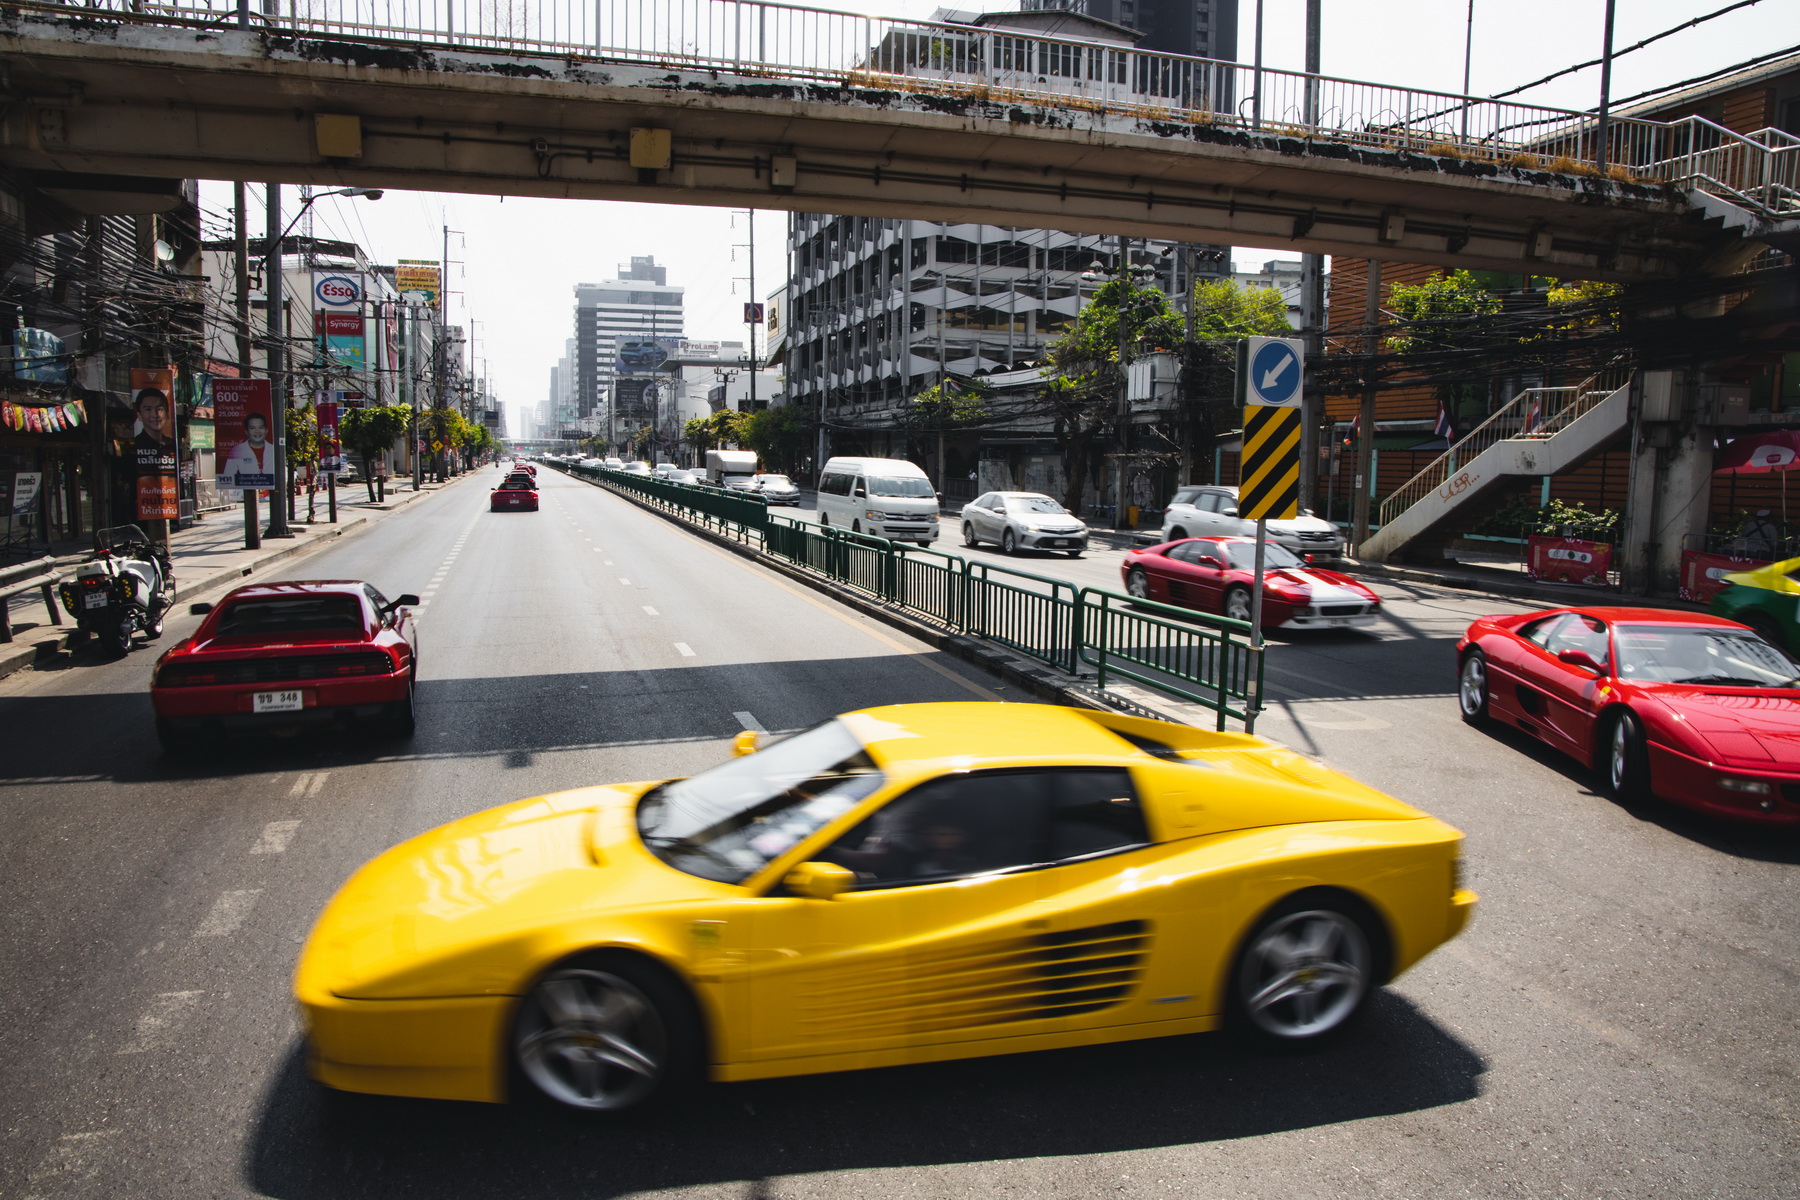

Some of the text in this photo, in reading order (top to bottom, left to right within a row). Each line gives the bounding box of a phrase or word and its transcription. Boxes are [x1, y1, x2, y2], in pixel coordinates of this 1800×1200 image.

[323, 284, 353, 297] Esso
[330, 320, 359, 329] Synergy
[686, 342, 718, 351] ProLamp
[216, 392, 239, 402] 600
[137, 455, 175, 465] เฉลิมชัย
[140, 486, 176, 494] คืนศักดิ์ศรี
[141, 495, 177, 505] คนไทย
[142, 506, 178, 515] ให้เท่ากัน
[280, 691, 298, 702] 348
